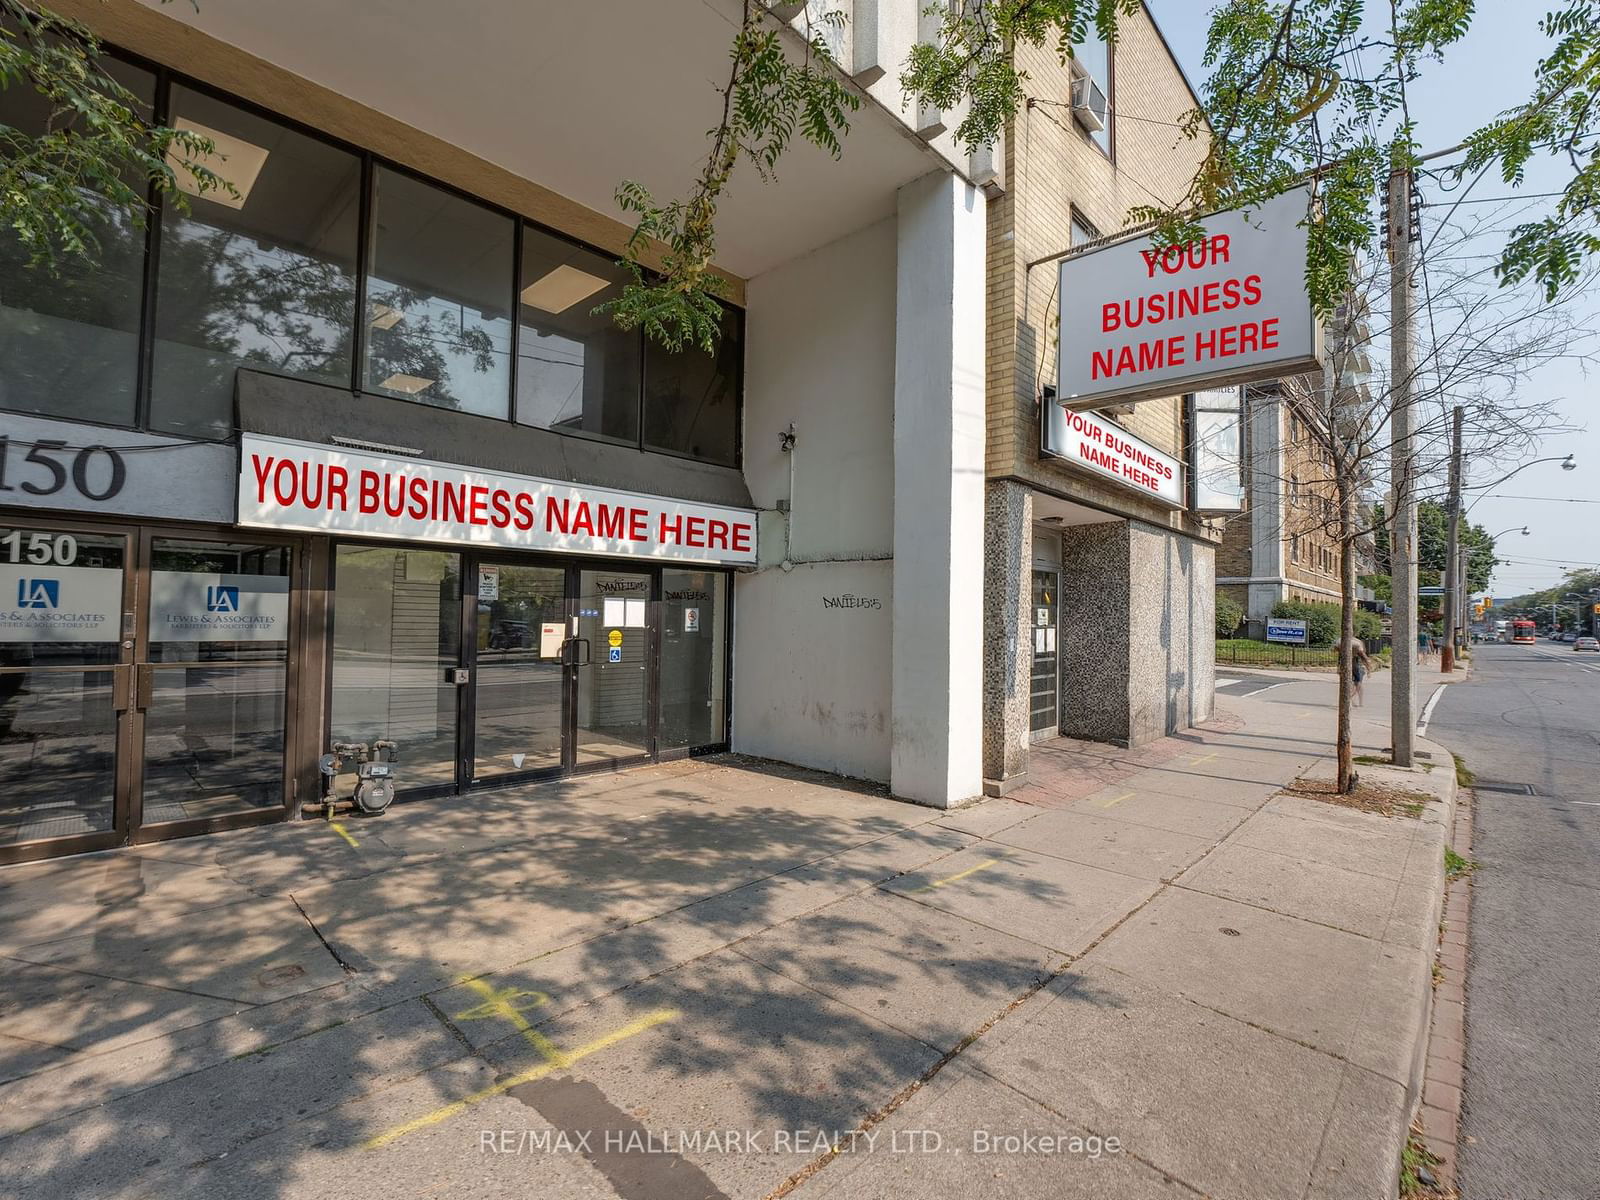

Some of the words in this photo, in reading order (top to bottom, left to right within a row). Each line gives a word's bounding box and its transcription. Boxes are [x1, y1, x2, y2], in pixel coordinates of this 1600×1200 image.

[1140, 234, 1230, 278] YOUR
[1102, 275, 1262, 333] BUSINESS
[1091, 335, 1185, 380] NAME
[1195, 318, 1279, 361] HERE
[0, 434, 126, 501] 150
[1065, 409, 1102, 443] YOUR
[1105, 433, 1172, 480] BUSINESS
[1080, 442, 1119, 474] NAME
[1123, 463, 1159, 491] HERE
[252, 454, 348, 511] YOUR
[359, 469, 534, 531] BUSINESS
[546, 496, 649, 542] NAME
[659, 512, 752, 552] HERE
[2, 530, 78, 565] 150
[201, 614, 210, 622] &
